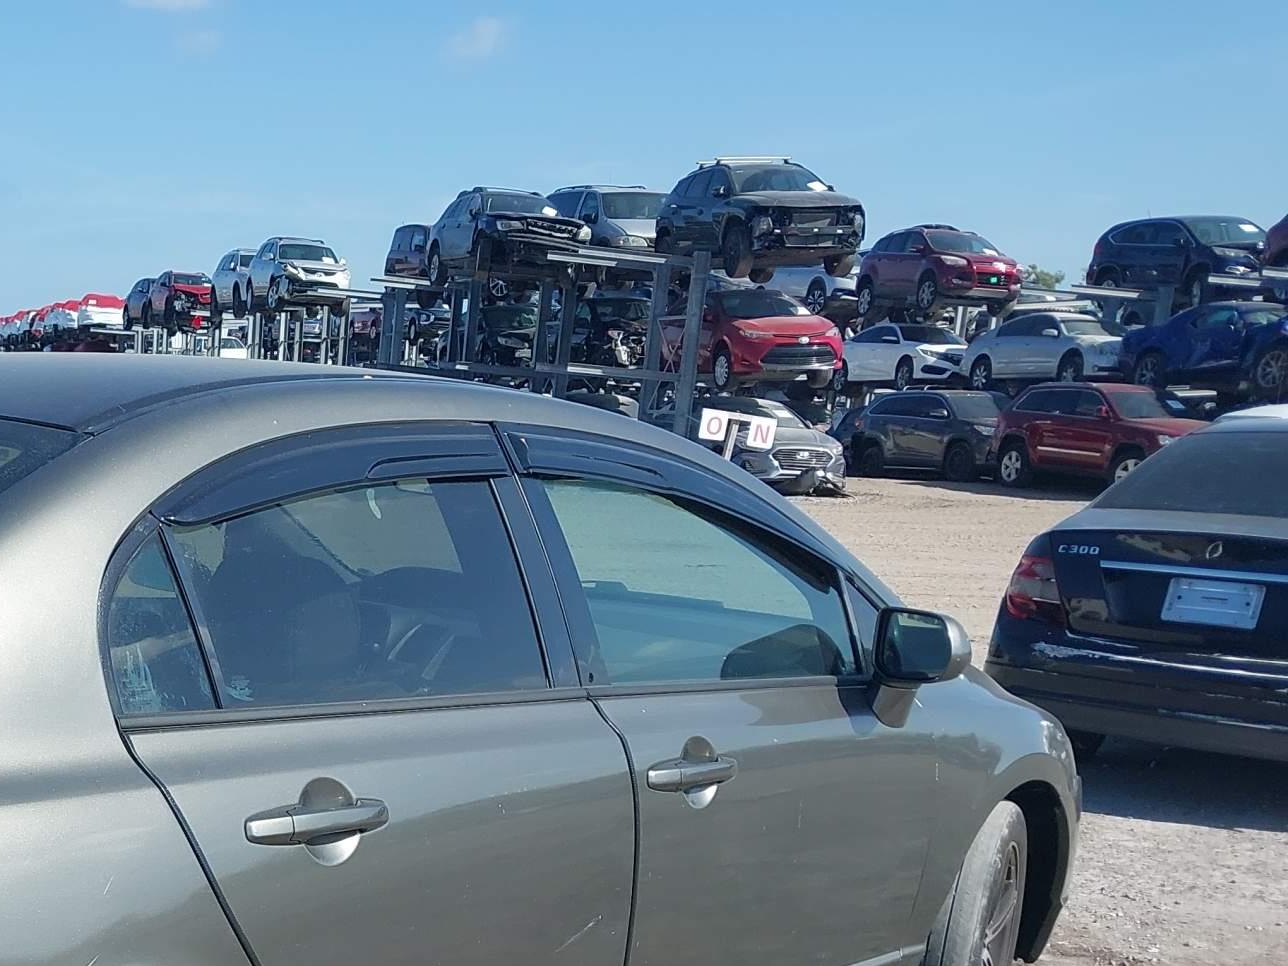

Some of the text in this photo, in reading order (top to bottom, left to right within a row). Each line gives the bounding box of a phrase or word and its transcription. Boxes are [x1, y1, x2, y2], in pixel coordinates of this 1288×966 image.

[706, 416, 722, 435] O
[753, 423, 771, 444] N
[1058, 544, 1100, 555] C300
